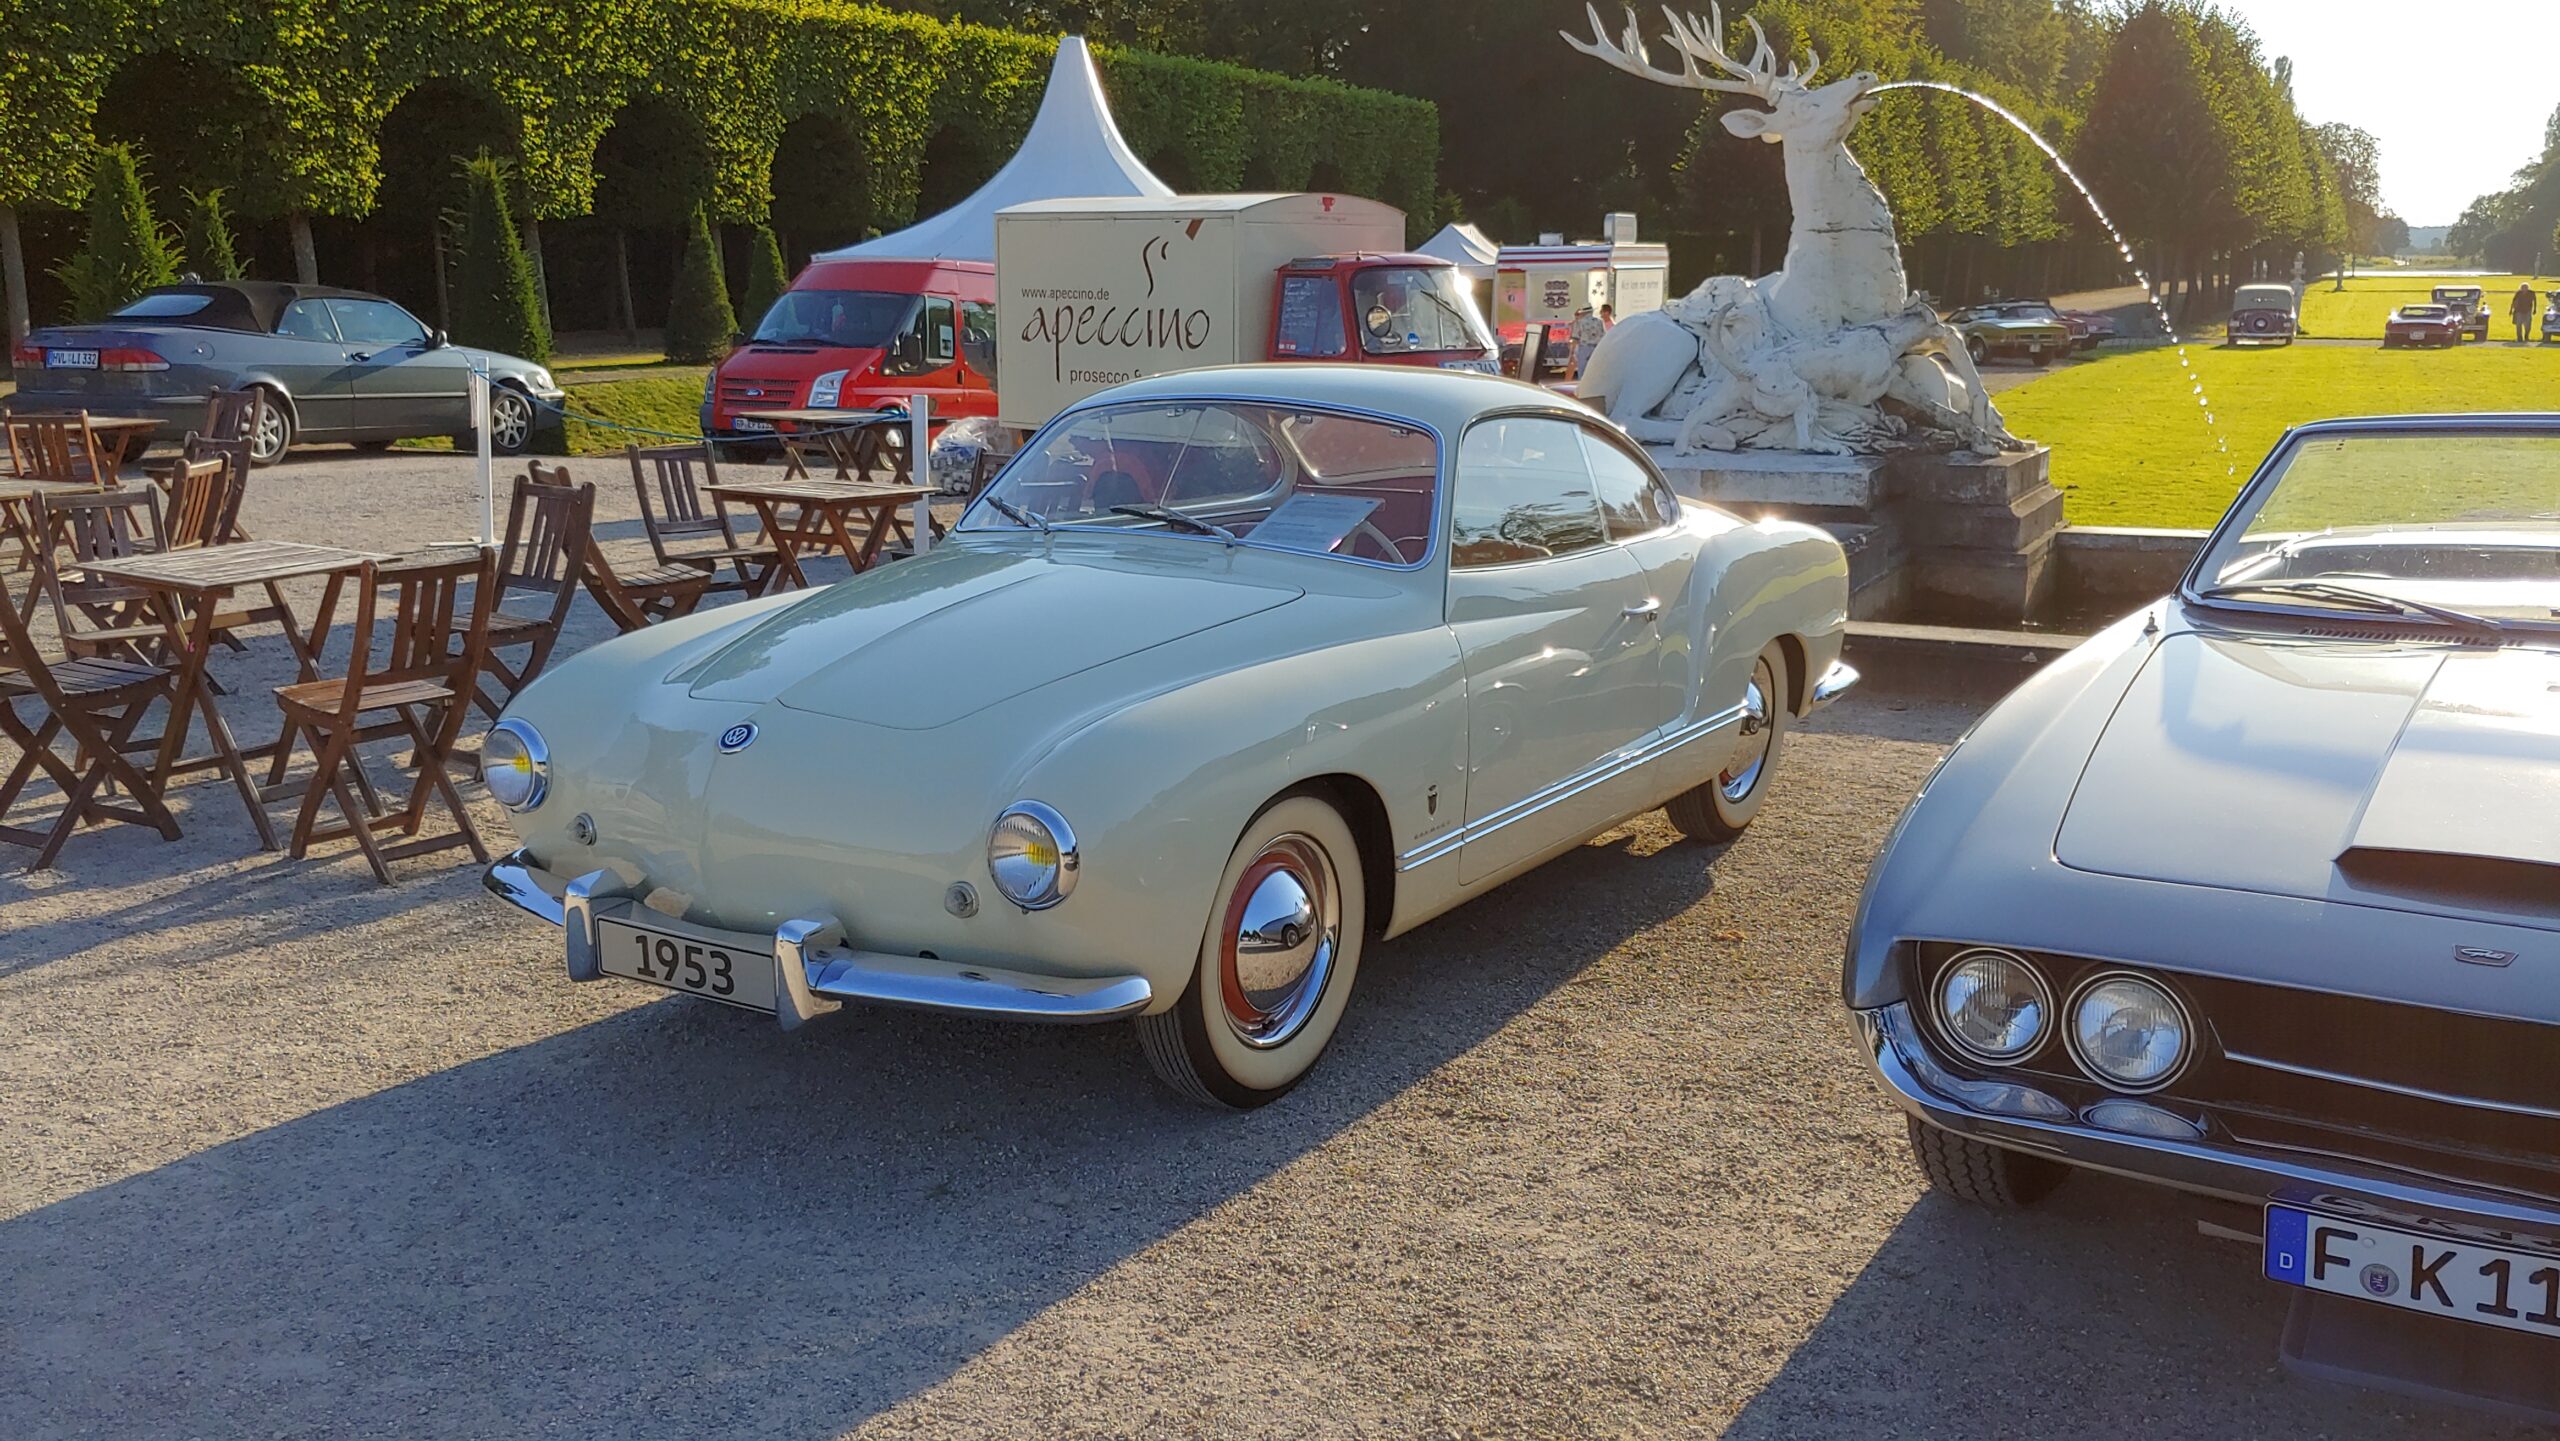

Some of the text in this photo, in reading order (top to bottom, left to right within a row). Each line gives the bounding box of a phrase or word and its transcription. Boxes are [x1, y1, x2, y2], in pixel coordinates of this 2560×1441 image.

[1021, 288, 1110, 301] www.apeccino.de
[82, 353, 97, 365] 332
[1021, 305, 1210, 383] apeccino
[635, 935, 735, 996] 1953
[2279, 1252, 2294, 1270] D
[2313, 1226, 2358, 1281] F
[2410, 1244, 2457, 1308] K
